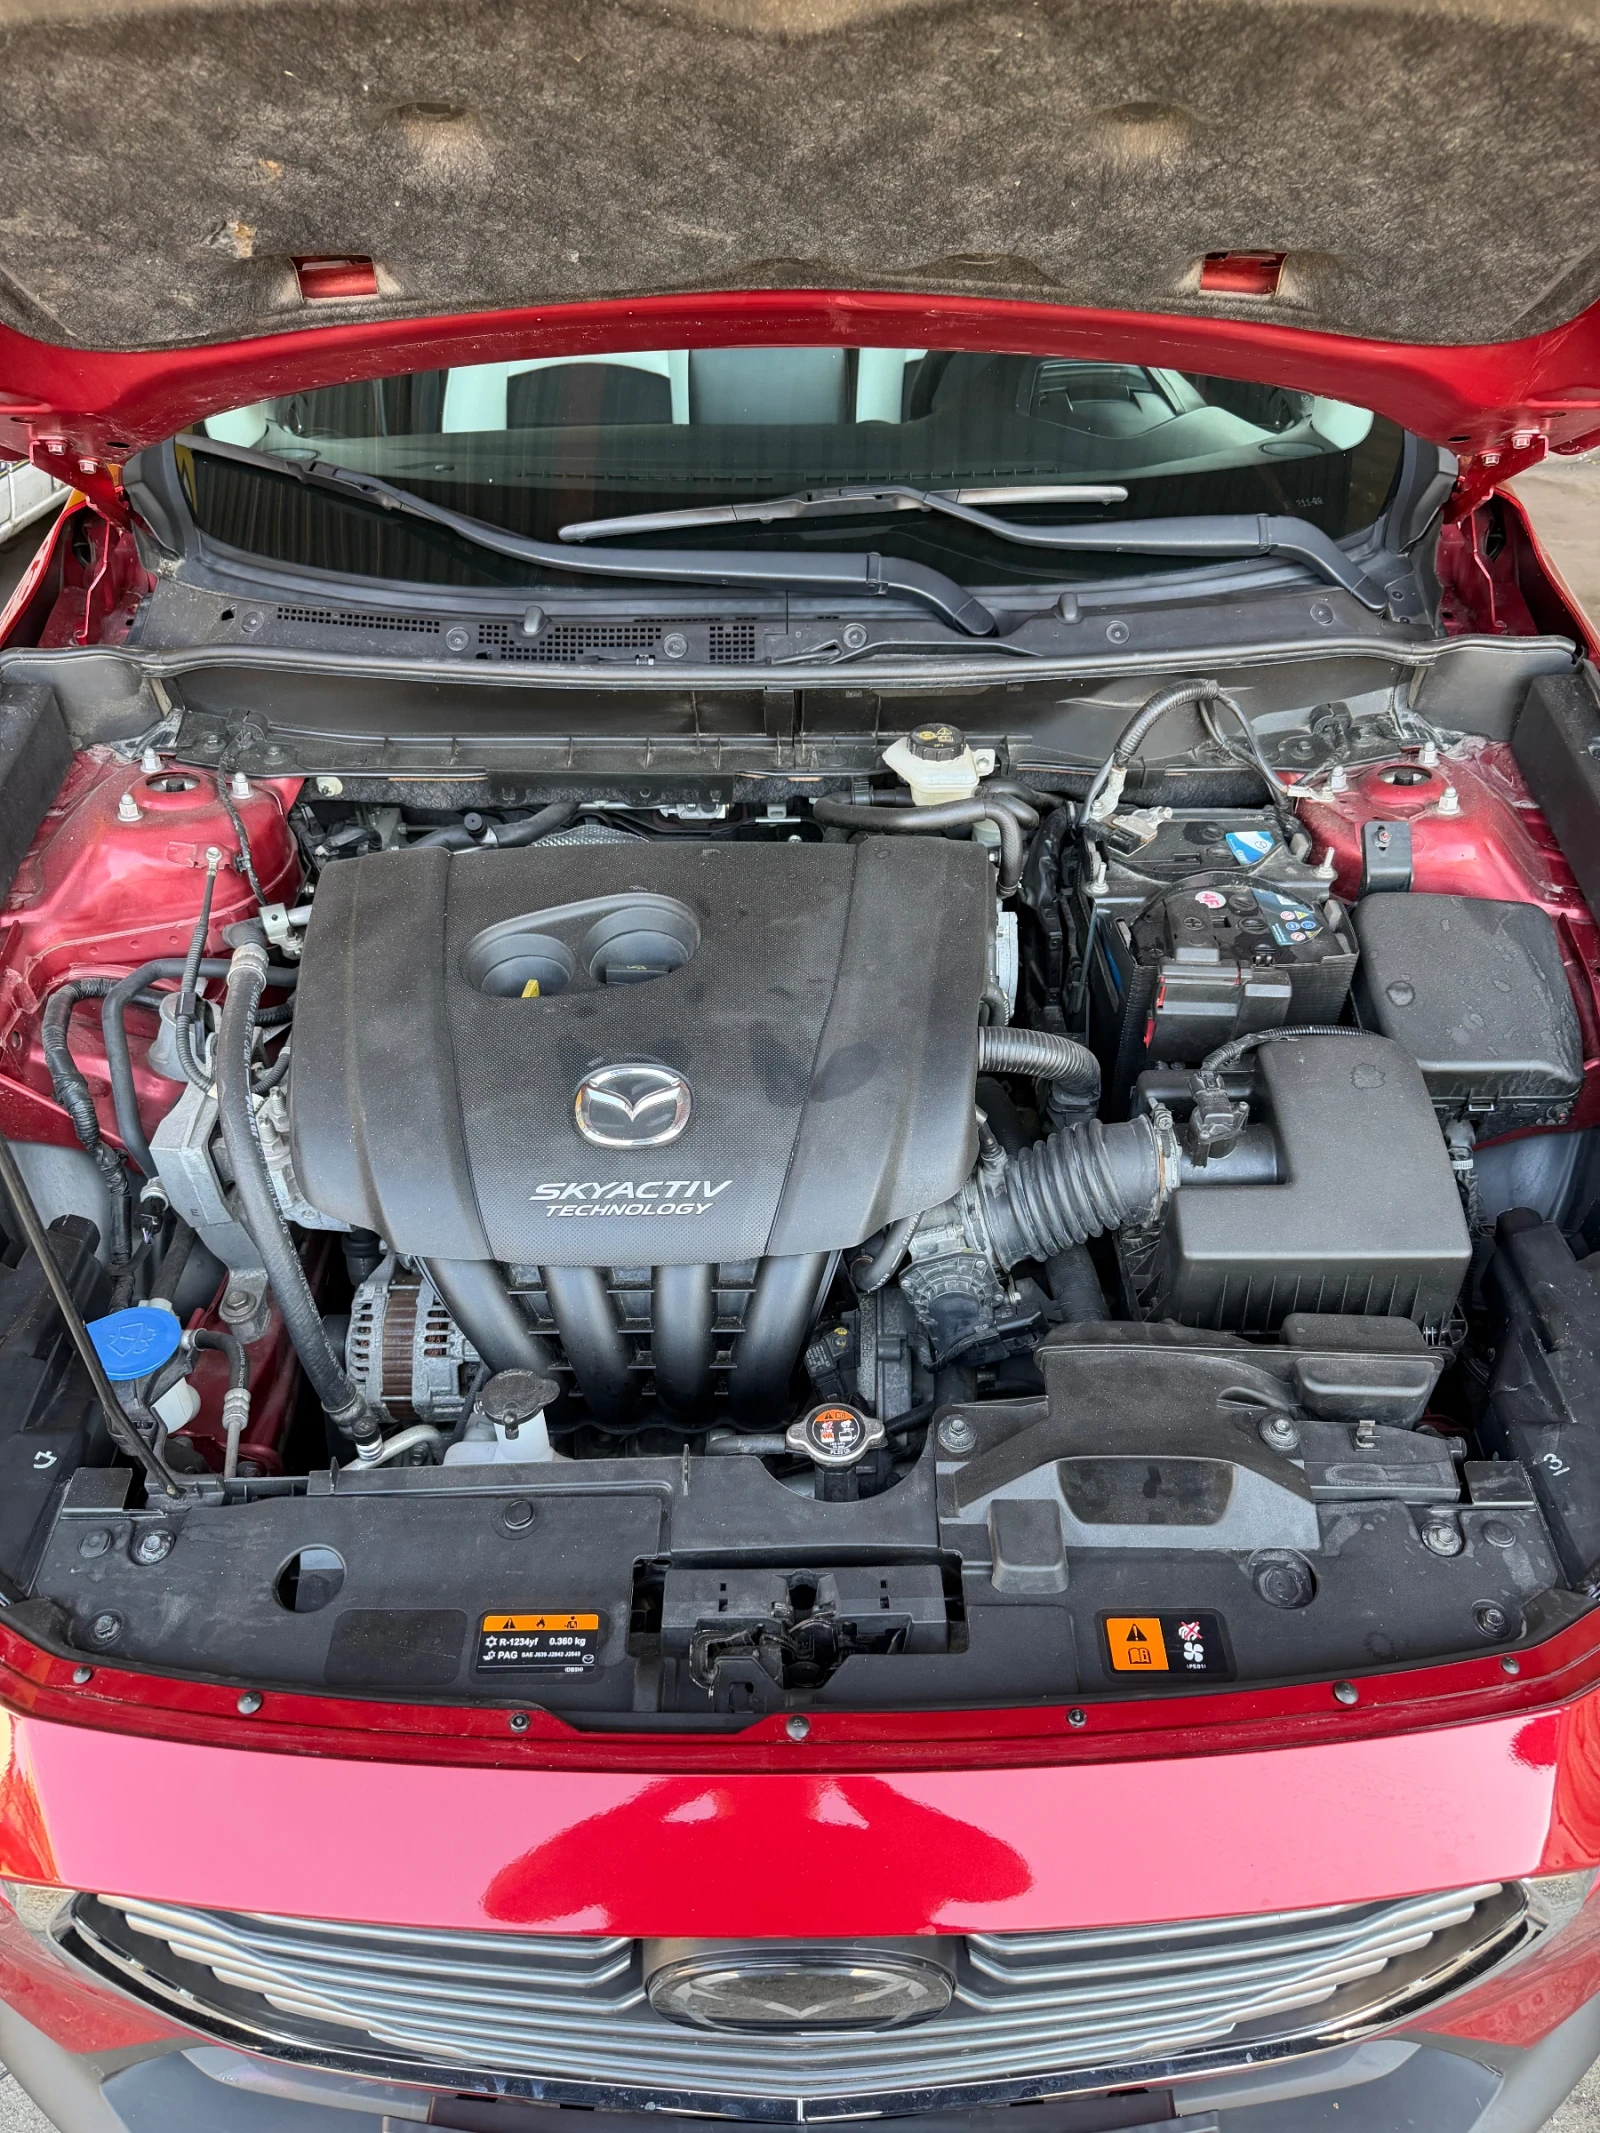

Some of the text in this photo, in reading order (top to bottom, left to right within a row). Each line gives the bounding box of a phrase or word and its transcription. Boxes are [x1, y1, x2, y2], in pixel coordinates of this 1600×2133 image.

[529, 1180, 733, 1201] SKYACTIV
[545, 1202, 713, 1217] TECHNOLOGY
[499, 1637, 586, 1647] R-1234yf 0.360 kg
[497, 1651, 518, 1659] PAG
